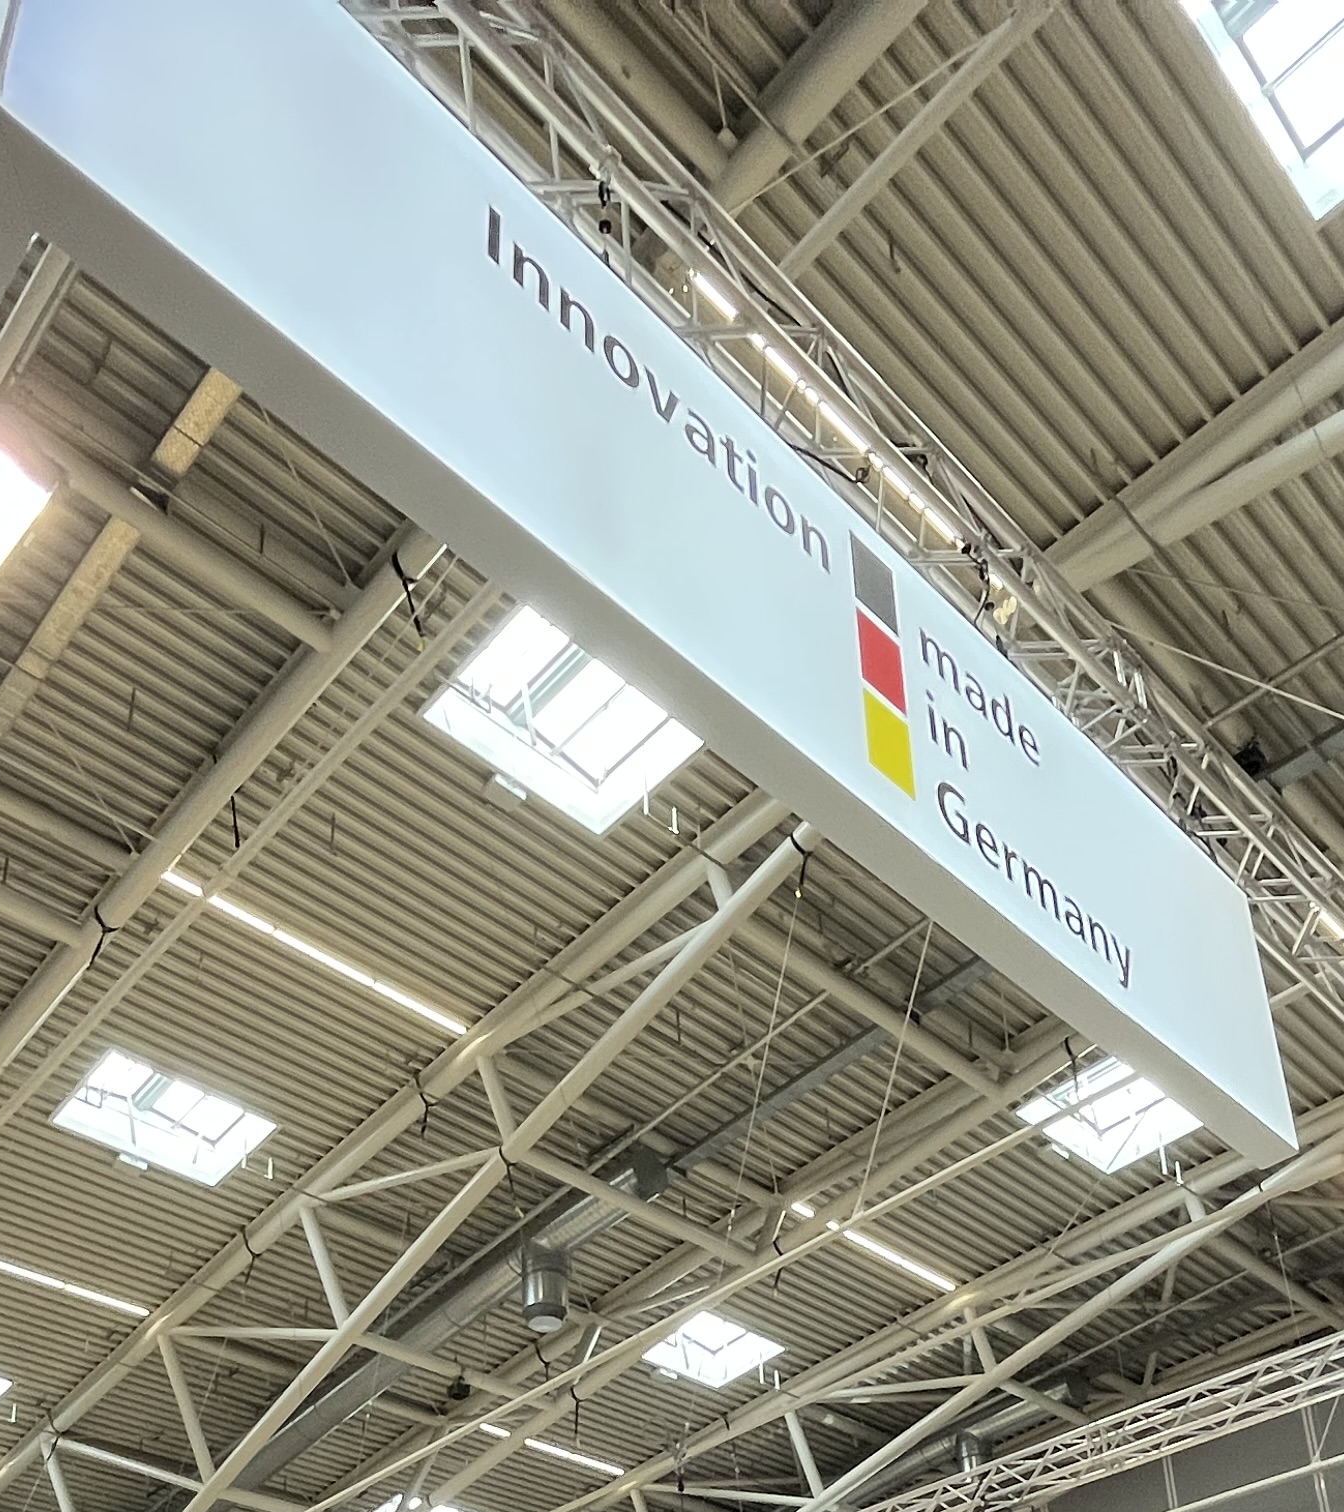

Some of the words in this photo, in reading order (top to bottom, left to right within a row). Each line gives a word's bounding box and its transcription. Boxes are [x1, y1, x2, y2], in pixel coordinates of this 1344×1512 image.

[485, 204, 832, 575] Innovation
[918, 625, 1042, 768] made
[925, 694, 970, 773] in
[936, 778, 1136, 991] Germany
